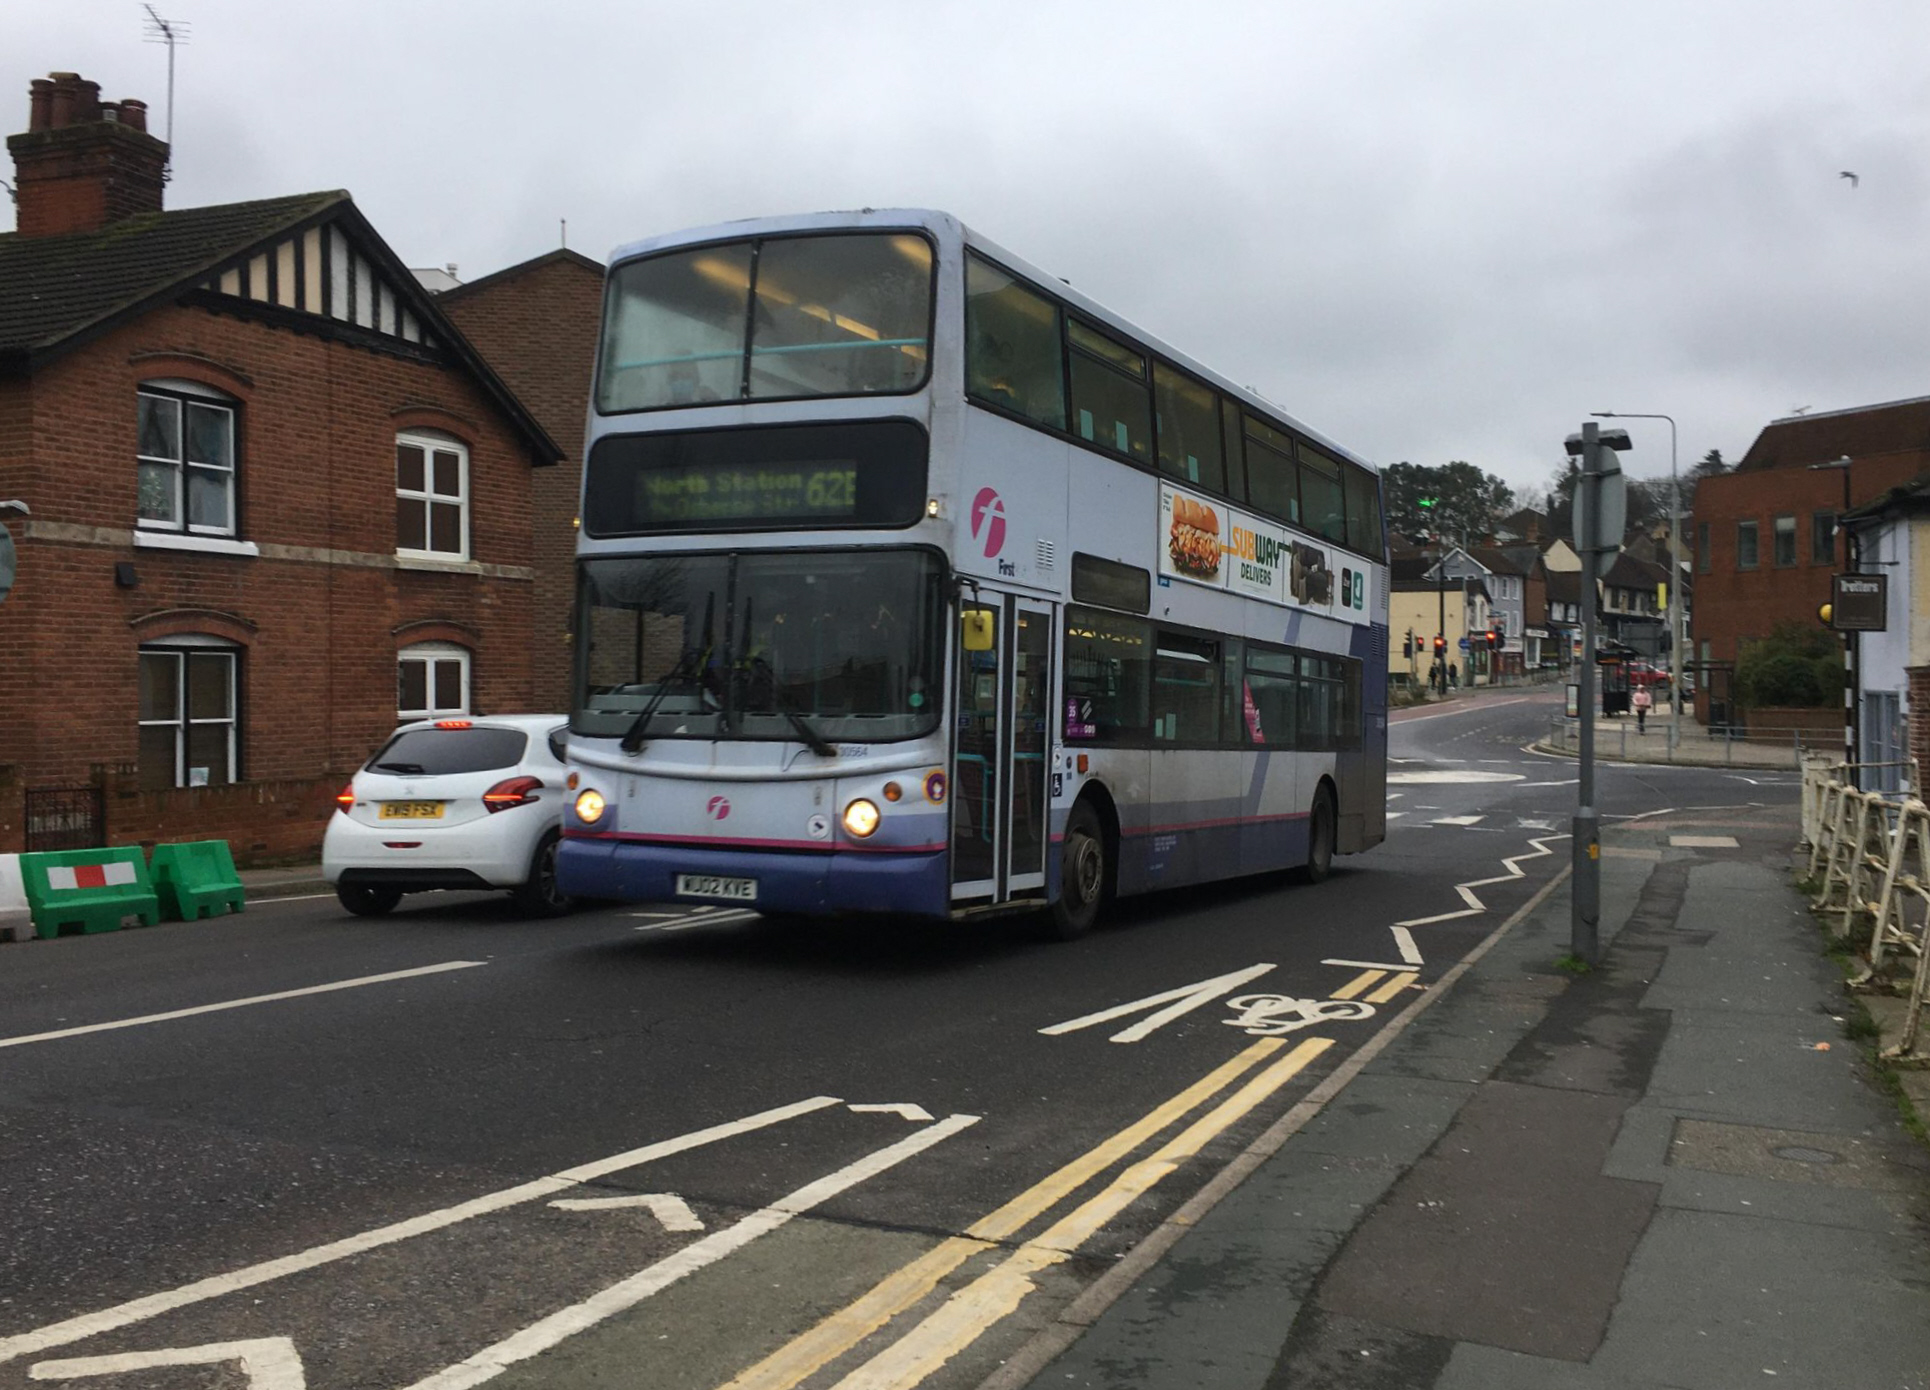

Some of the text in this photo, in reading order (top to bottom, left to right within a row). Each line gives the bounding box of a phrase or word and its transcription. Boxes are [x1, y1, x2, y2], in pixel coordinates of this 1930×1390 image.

[1229, 527, 1283, 569] SUBWAY
[998, 558, 1015, 577] First
[1240, 562, 1272, 587] DELIVERS
[722, 879, 753, 897] KVE
